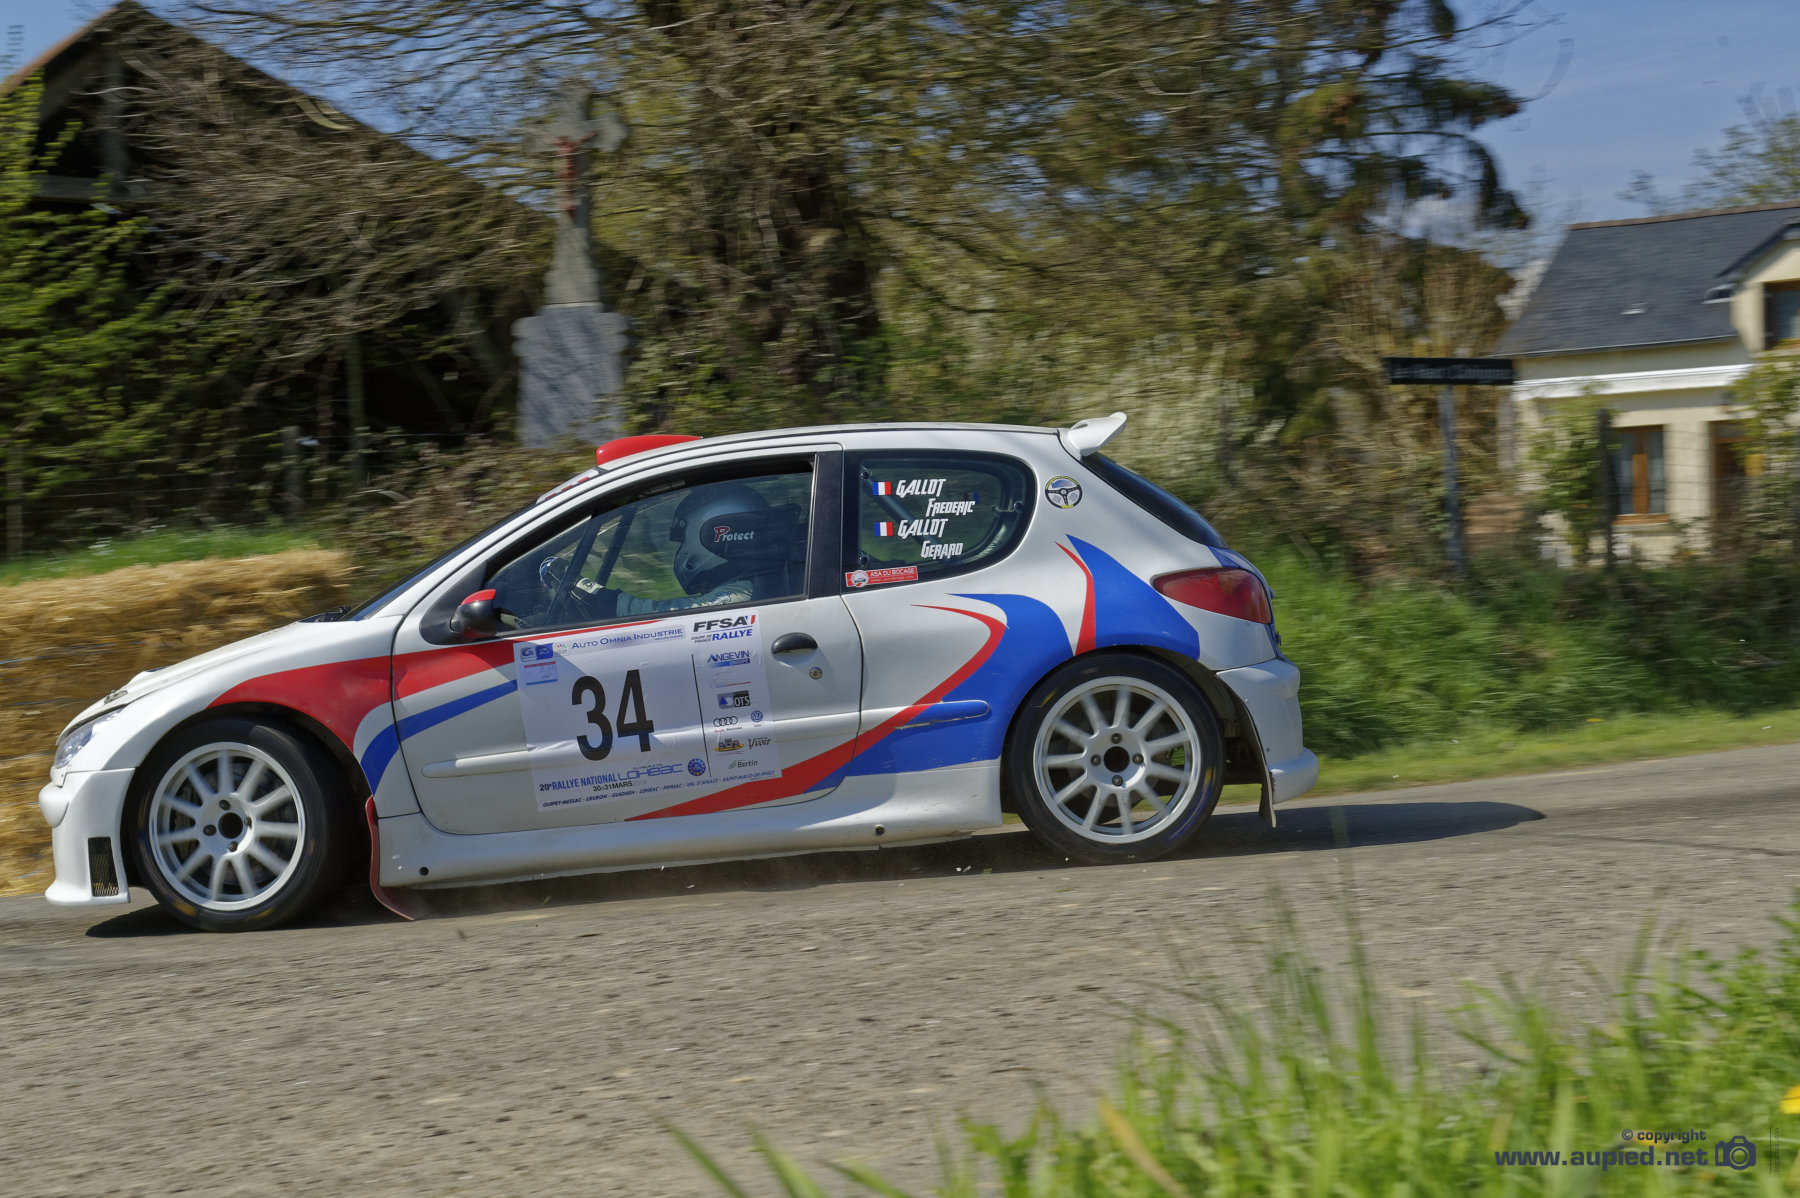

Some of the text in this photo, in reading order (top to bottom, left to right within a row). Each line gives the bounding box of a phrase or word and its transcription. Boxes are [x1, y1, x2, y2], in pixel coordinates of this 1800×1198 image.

[895, 478, 947, 499] GALLOT
[925, 498, 976, 518] FREDERIC
[713, 525, 755, 544] Protect
[897, 518, 949, 540] GALLOT
[920, 540, 964, 560] GERARD
[693, 616, 749, 633] FFSA
[711, 628, 753, 642] RALLYE
[571, 668, 655, 761] 34
[552, 778, 580, 791] RALLYE
[580, 772, 618, 787] NATIONAL
